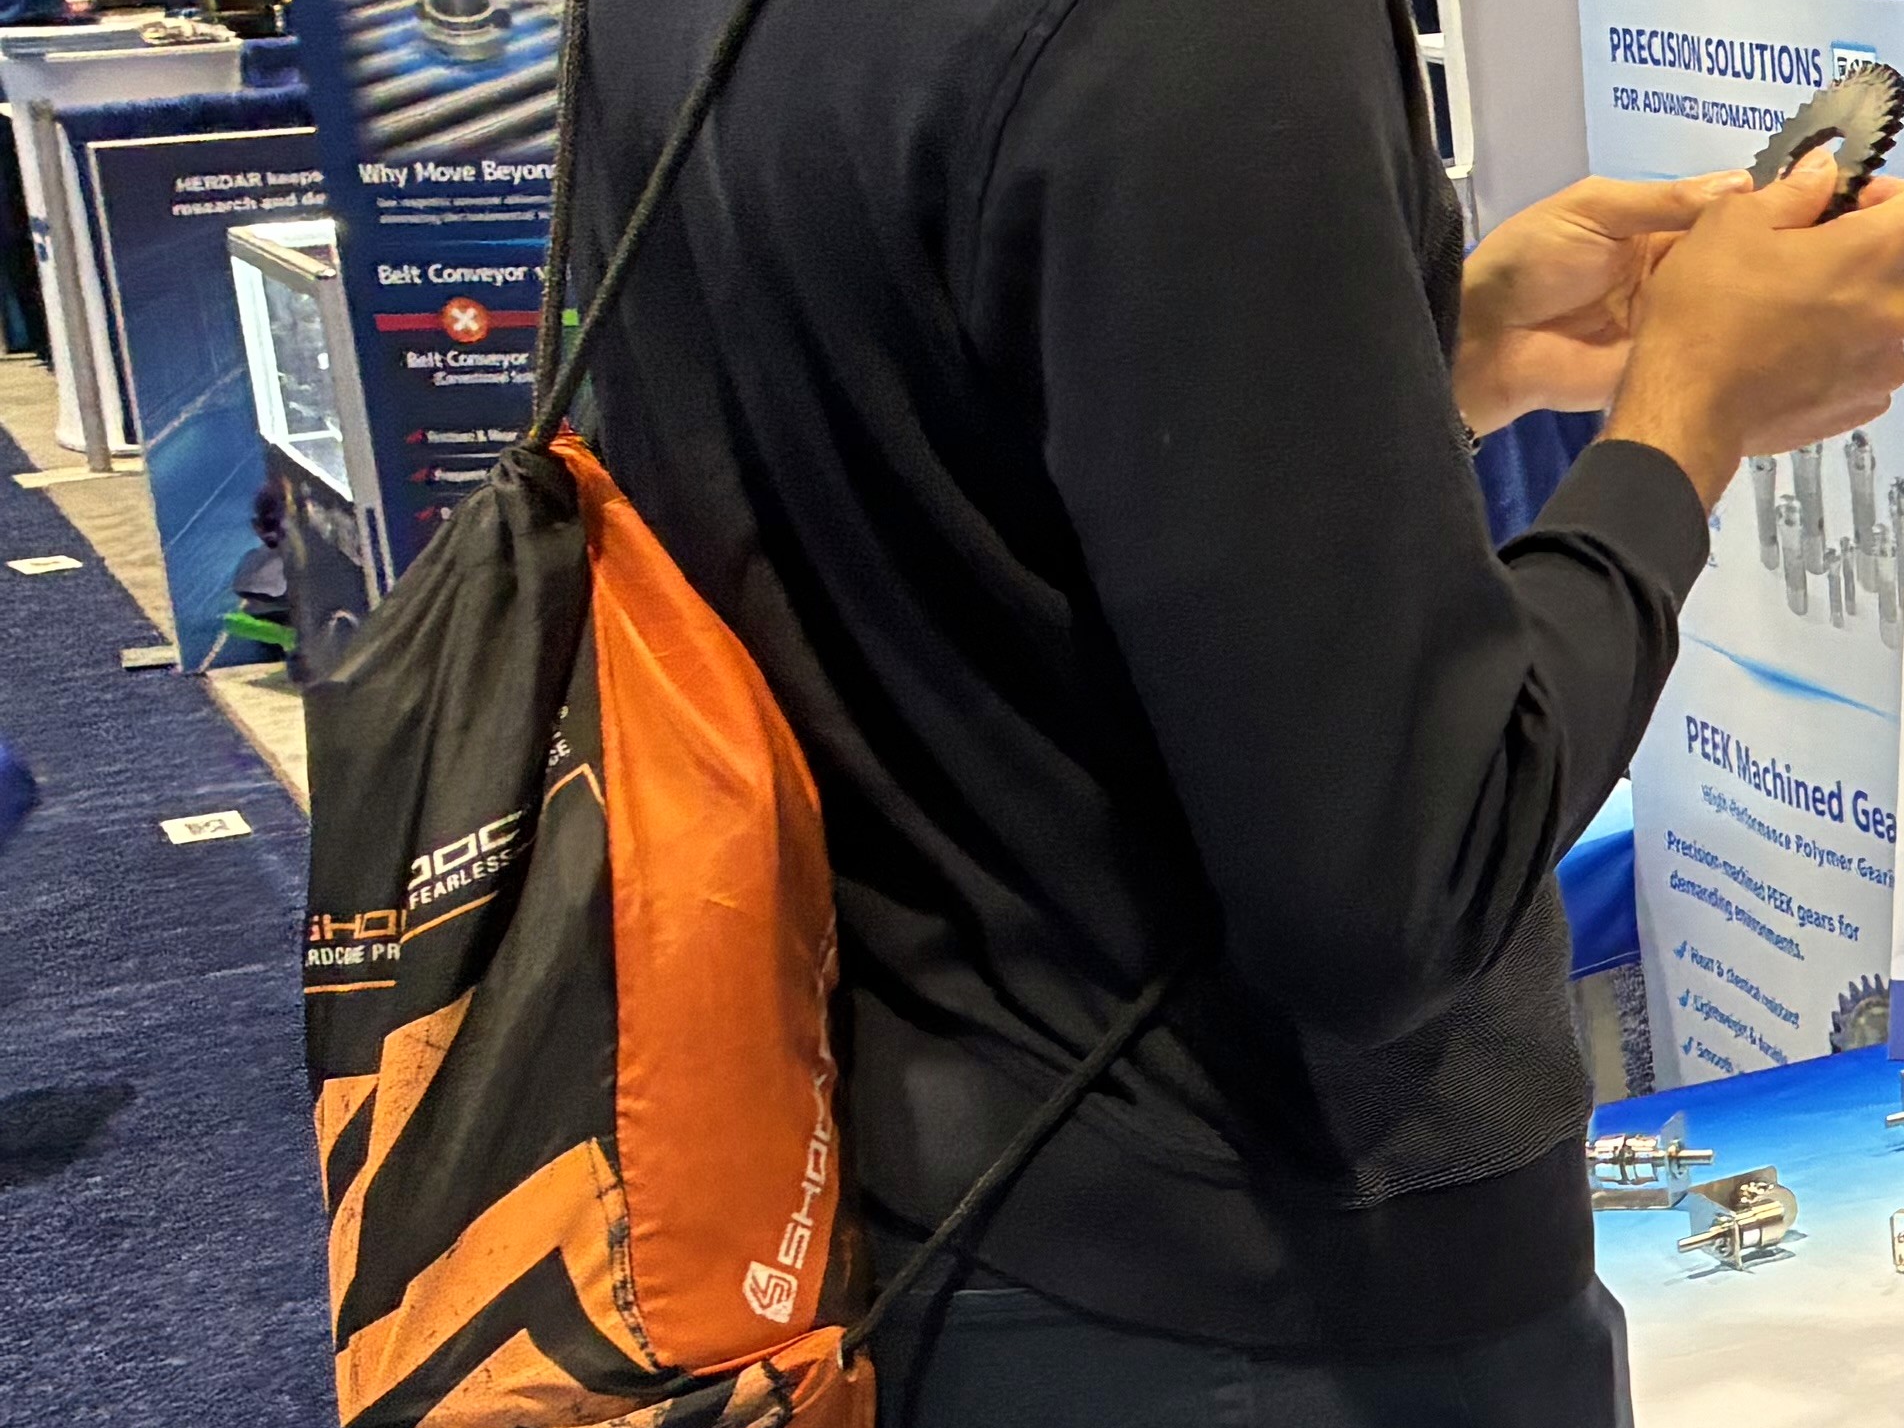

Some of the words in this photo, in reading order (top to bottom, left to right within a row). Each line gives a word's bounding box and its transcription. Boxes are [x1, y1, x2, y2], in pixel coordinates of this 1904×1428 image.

[1610, 26, 1702, 73] PRECISION
[1704, 38, 1823, 88] SOLUTIONS
[1612, 86, 1640, 112] FOR
[1643, 90, 1700, 120] ADVANCED
[1701, 101, 1786, 132] AUTOMATION
[358, 162, 408, 188] Why
[413, 162, 476, 184] Move
[377, 264, 422, 286] Belt
[427, 264, 528, 285] Conveyor
[1686, 715, 1733, 773] PEEK
[1735, 740, 1844, 823] Machined
